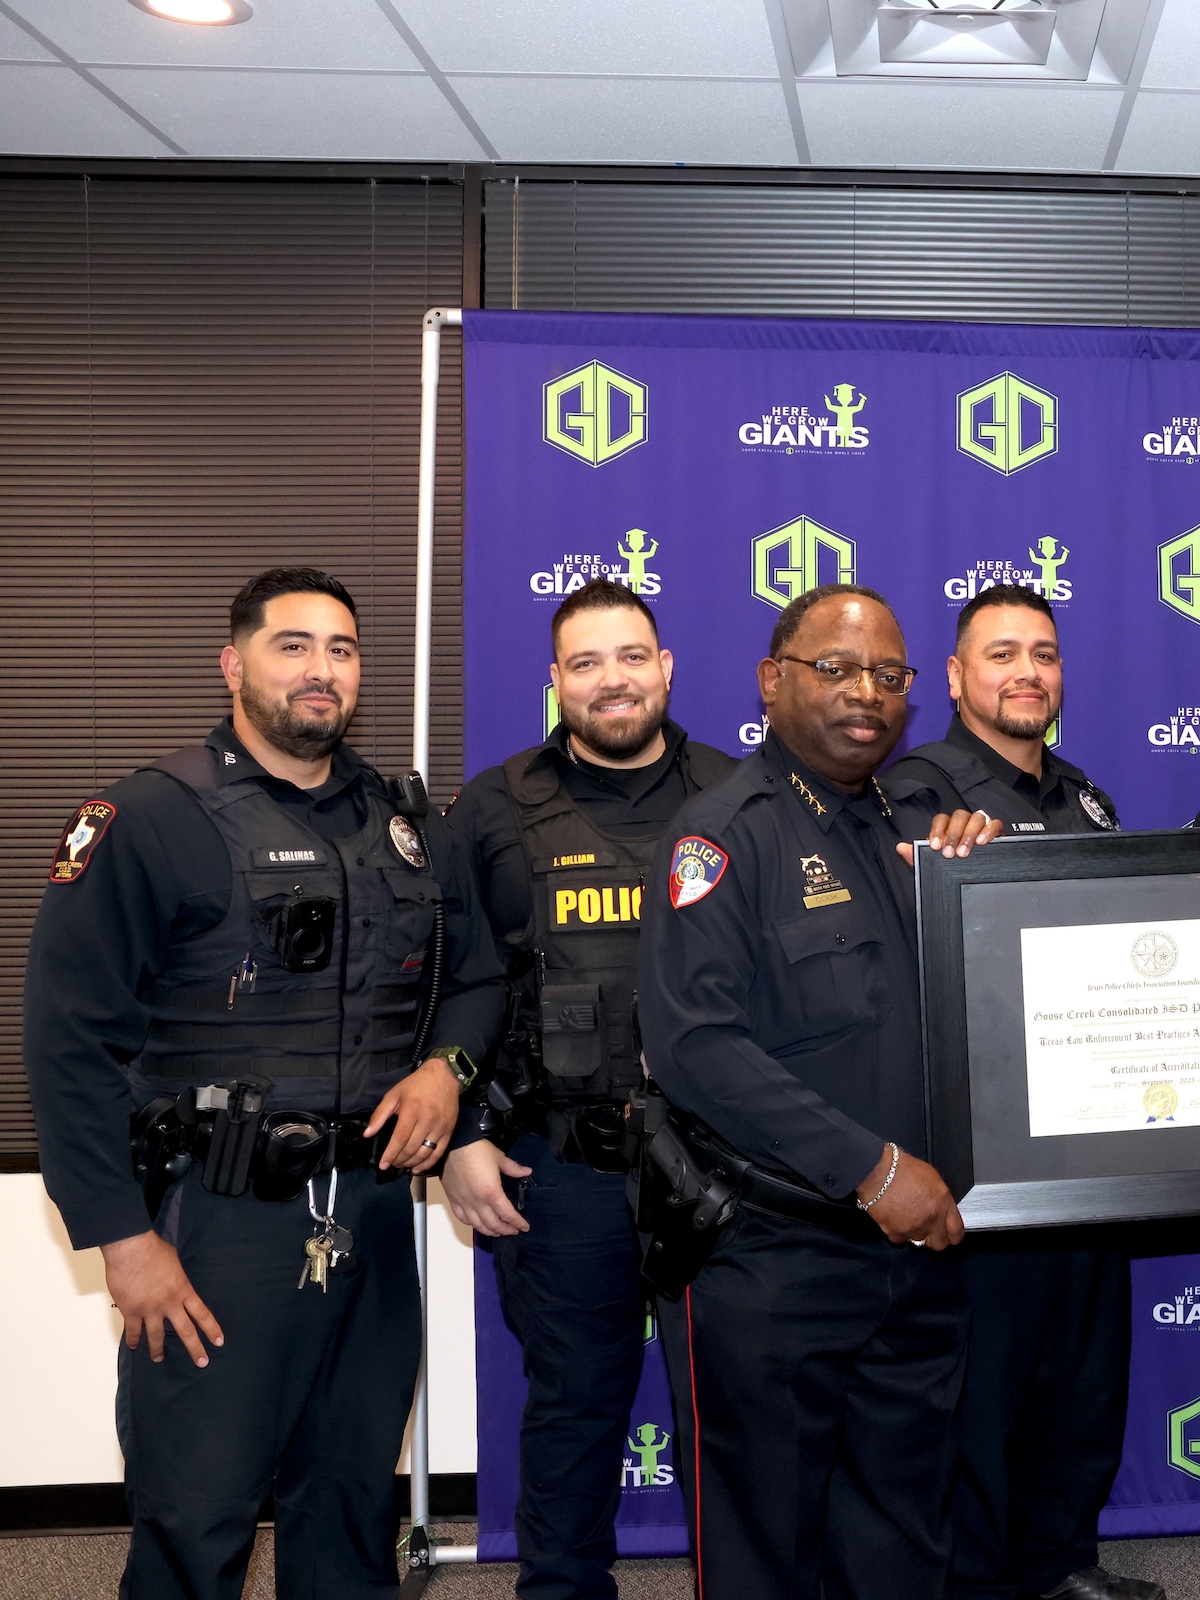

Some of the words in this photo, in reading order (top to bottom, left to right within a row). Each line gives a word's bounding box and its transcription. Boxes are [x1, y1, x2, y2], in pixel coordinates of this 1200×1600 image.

[772, 407, 810, 417] HERE,
[762, 415, 781, 424] WE
[788, 416, 828, 426] GROW
[739, 423, 869, 448] GIANTS
[1163, 426, 1181, 435] WE
[564, 555, 603, 564] HERE,
[553, 564, 573, 573] WE
[581, 564, 621, 573] GROW
[977, 561, 1014, 570] HERE,
[967, 570, 985, 578] WE
[993, 570, 1033, 579] GROW
[530, 572, 661, 595] GIATS
[1170, 716, 1185, 725] WE
[78, 806, 110, 818] POLICE
[1019, 822, 1045, 831] MOLINA
[269, 852, 278, 861] G.
[279, 850, 315, 861] SALINAS
[679, 842, 721, 867] POLICE
[553, 858, 559, 866] J.
[561, 854, 595, 866] GILLIAM
[816, 894, 838, 902] COOK
[1034, 1012, 1063, 1021] Goose
[1067, 1009, 1095, 1019] Creek
[1098, 1004, 1158, 1017] Consolidated
[1039, 1037, 1063, 1046] Texas
[1067, 1036, 1083, 1044] Law
[1086, 1034, 1132, 1043] Enforcement
[1135, 1032, 1153, 1040] Best
[1156, 1030, 1190, 1039] Practices
[1111, 1065, 1149, 1074] Certificate
[1152, 1063, 1158, 1072] of
[1175, 1296, 1193, 1304] WE
